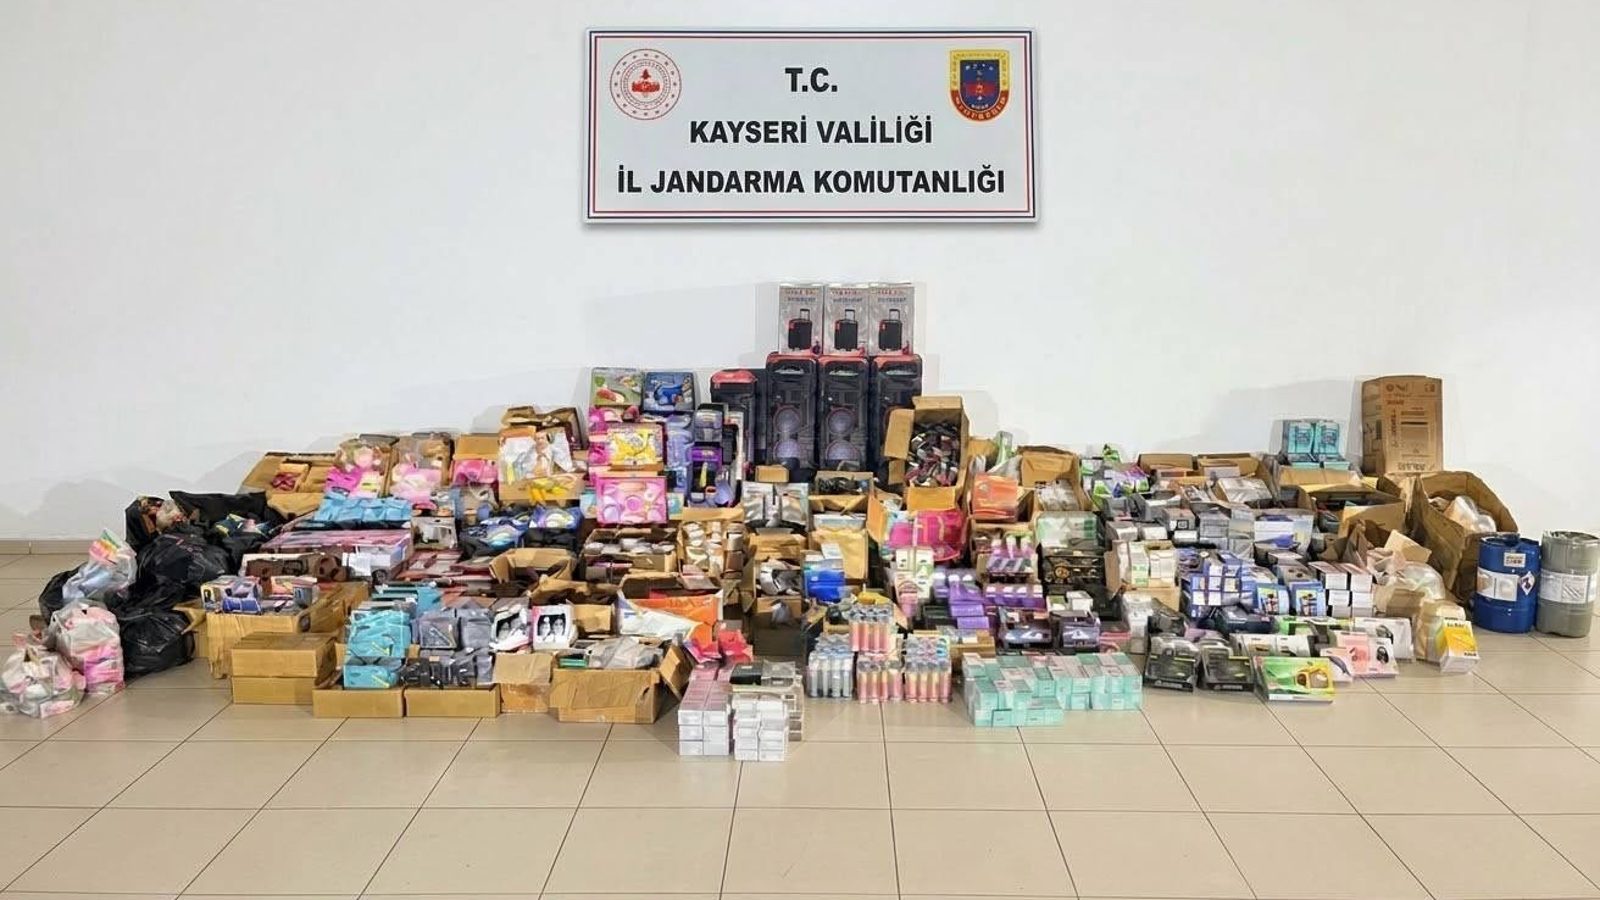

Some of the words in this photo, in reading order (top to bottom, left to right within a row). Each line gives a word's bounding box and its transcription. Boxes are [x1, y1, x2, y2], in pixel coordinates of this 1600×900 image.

[785, 67, 838, 92] T.C.
[690, 115, 807, 143] KAYSERİ
[817, 115, 932, 143] VALİLİĞİ
[617, 164, 642, 193] İL
[651, 170, 805, 193] JANDARMA
[815, 164, 1005, 193] KOMUTANLIĞI
